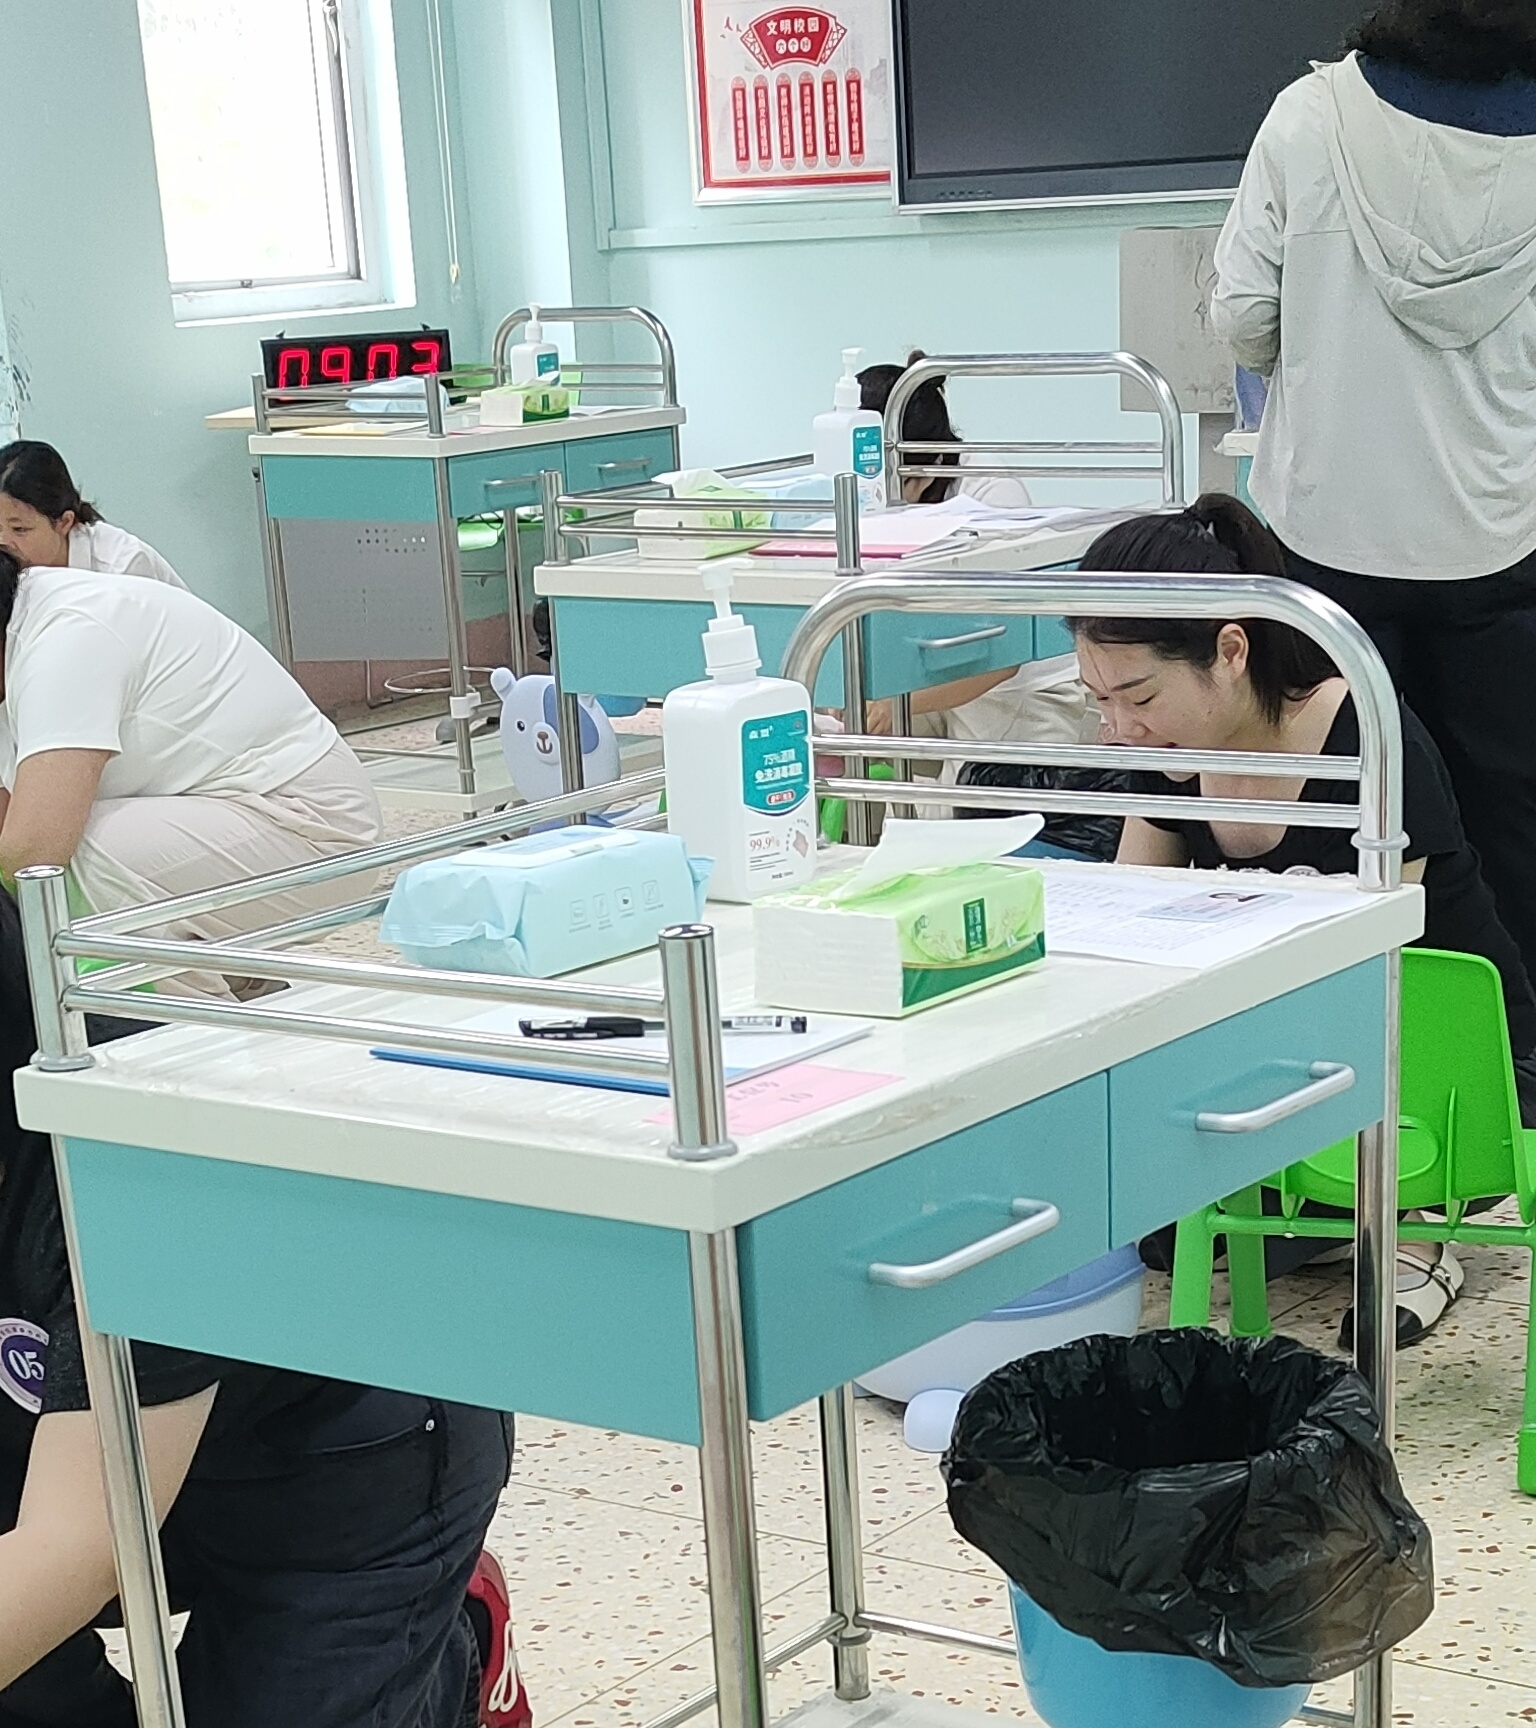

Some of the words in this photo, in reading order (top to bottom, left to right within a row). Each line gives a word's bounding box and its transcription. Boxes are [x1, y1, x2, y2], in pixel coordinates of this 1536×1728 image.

[766, 16, 820, 36] 文明校园
[8, 1349, 45, 1381] 05
